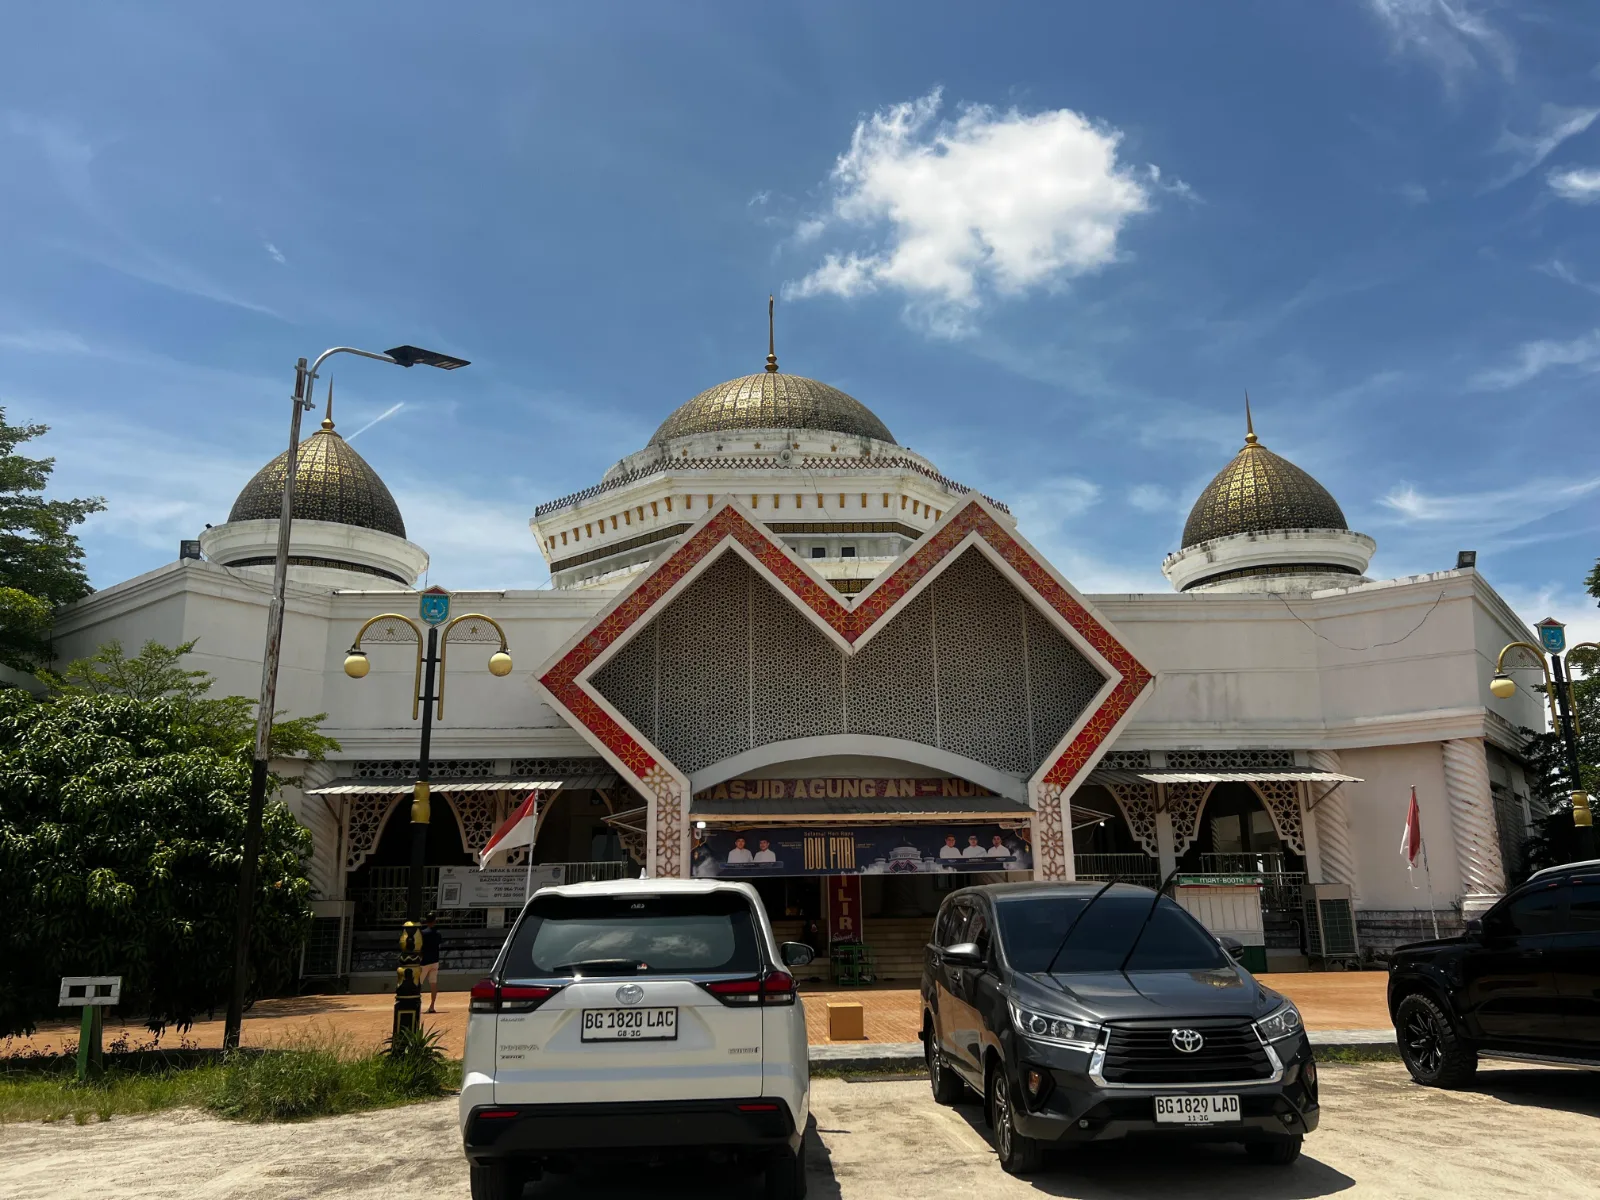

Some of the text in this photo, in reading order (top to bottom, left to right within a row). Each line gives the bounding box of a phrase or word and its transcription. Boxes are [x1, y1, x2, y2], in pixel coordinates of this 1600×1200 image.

[793, 779, 876, 799] AGUNG
[804, 837, 856, 870] IDUL FITRI
[585, 1010, 675, 1030] BG 1820 LAC
[1157, 1097, 1238, 1114] BG 1829 LAD
